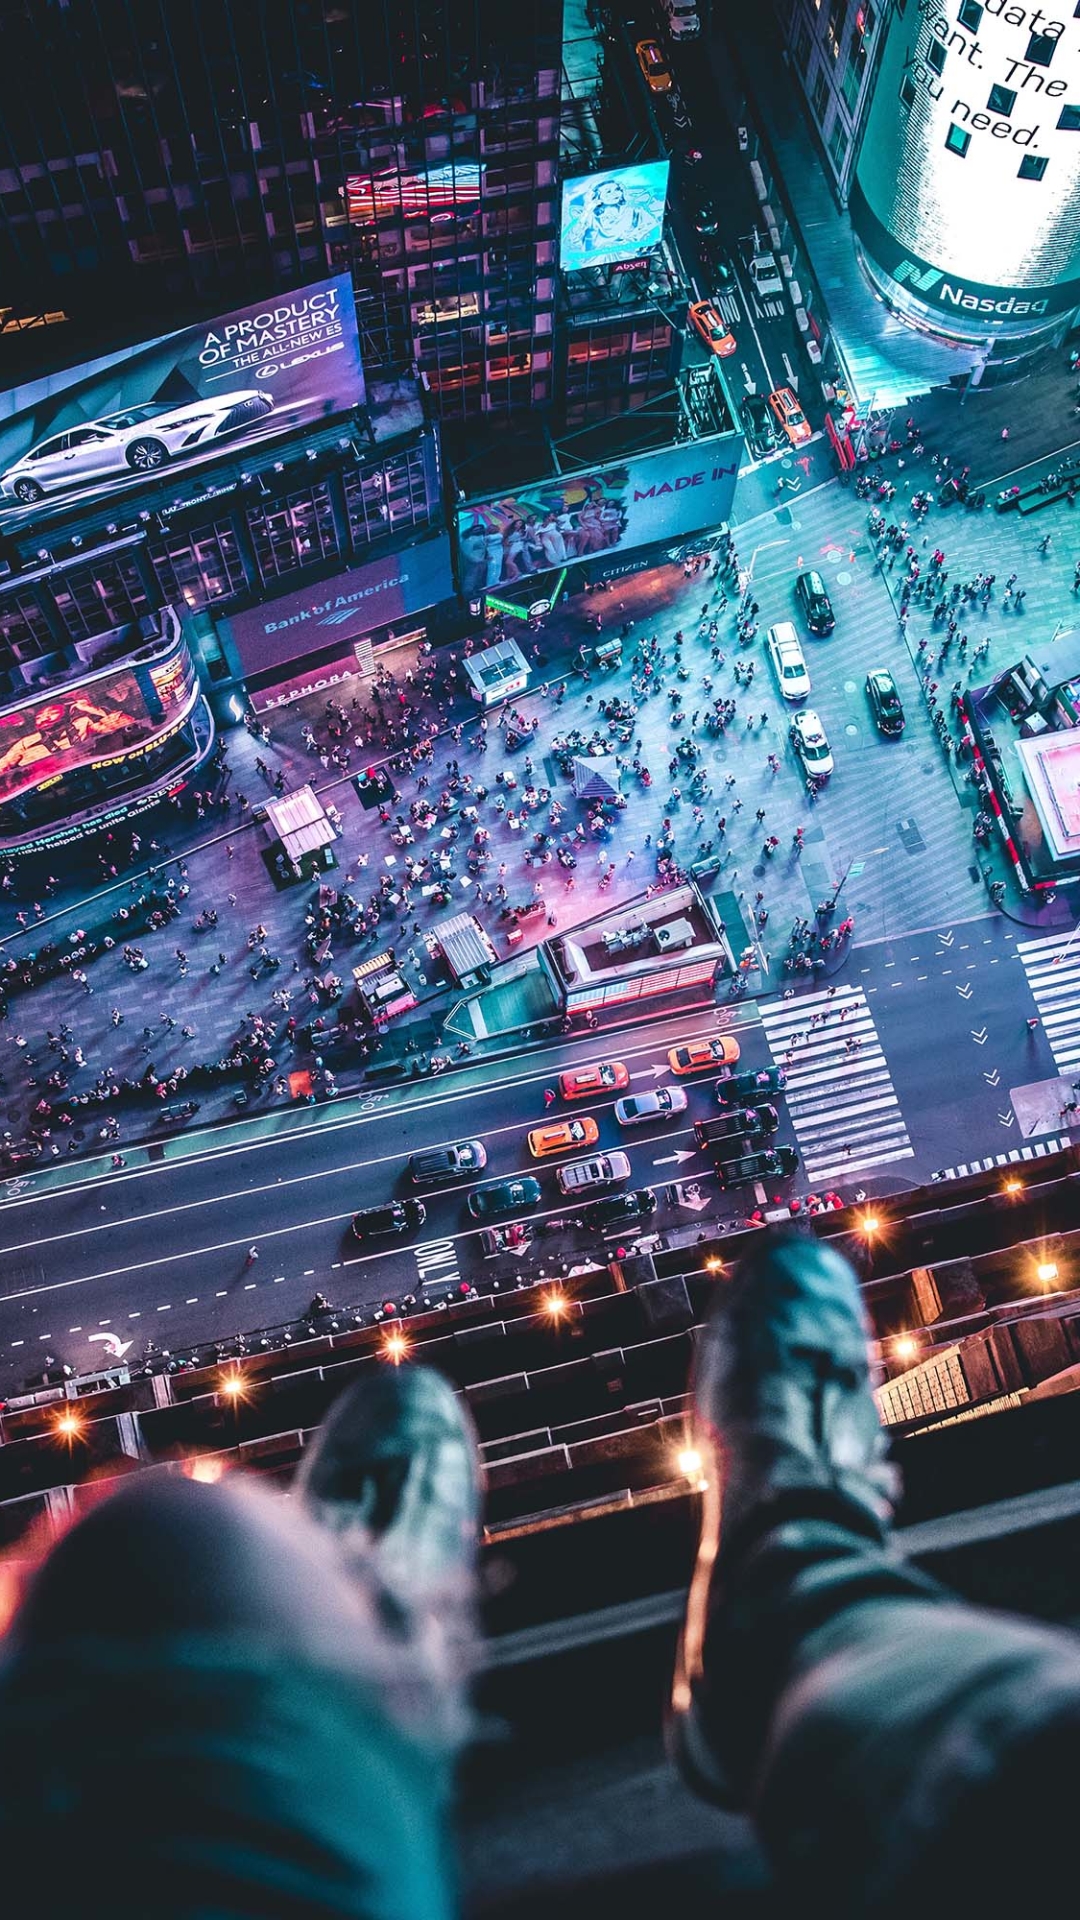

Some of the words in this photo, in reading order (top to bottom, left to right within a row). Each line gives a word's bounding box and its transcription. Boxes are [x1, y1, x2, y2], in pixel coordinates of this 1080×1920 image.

[1005, 57, 1068, 97] The
[950, 99, 1039, 149] need.
[615, 261, 647, 271] Absen
[204, 332, 221, 349] A
[224, 288, 338, 341] PRODUCT
[708, 295, 741, 325] ONL
[939, 283, 1049, 315] Nasdaq
[199, 343, 232, 365] OF
[236, 304, 340, 353] MASTERY
[232, 352, 260, 369] THE
[262, 329, 323, 359] ALL-NEW
[327, 323, 343, 335] ES
[280, 341, 345, 370] LEXUS
[633, 471, 706, 503] MADE
[711, 463, 737, 481] IN
[602, 560, 649, 577] CITIZEN
[264, 610, 312, 635] Bank
[313, 599, 332, 615] of
[334, 573, 410, 608] America
[265, 670, 352, 708] SEPHORA
[91, 755, 127, 770] NOW
[128, 748, 145, 760] ON
[45, 832, 84, 849] helped
[85, 827, 97, 836] to
[98, 816, 126, 830] unite
[127, 799, 161, 818] Giants
[104, 805, 128, 820] died
[413, 1241, 461, 1286] ONLY
